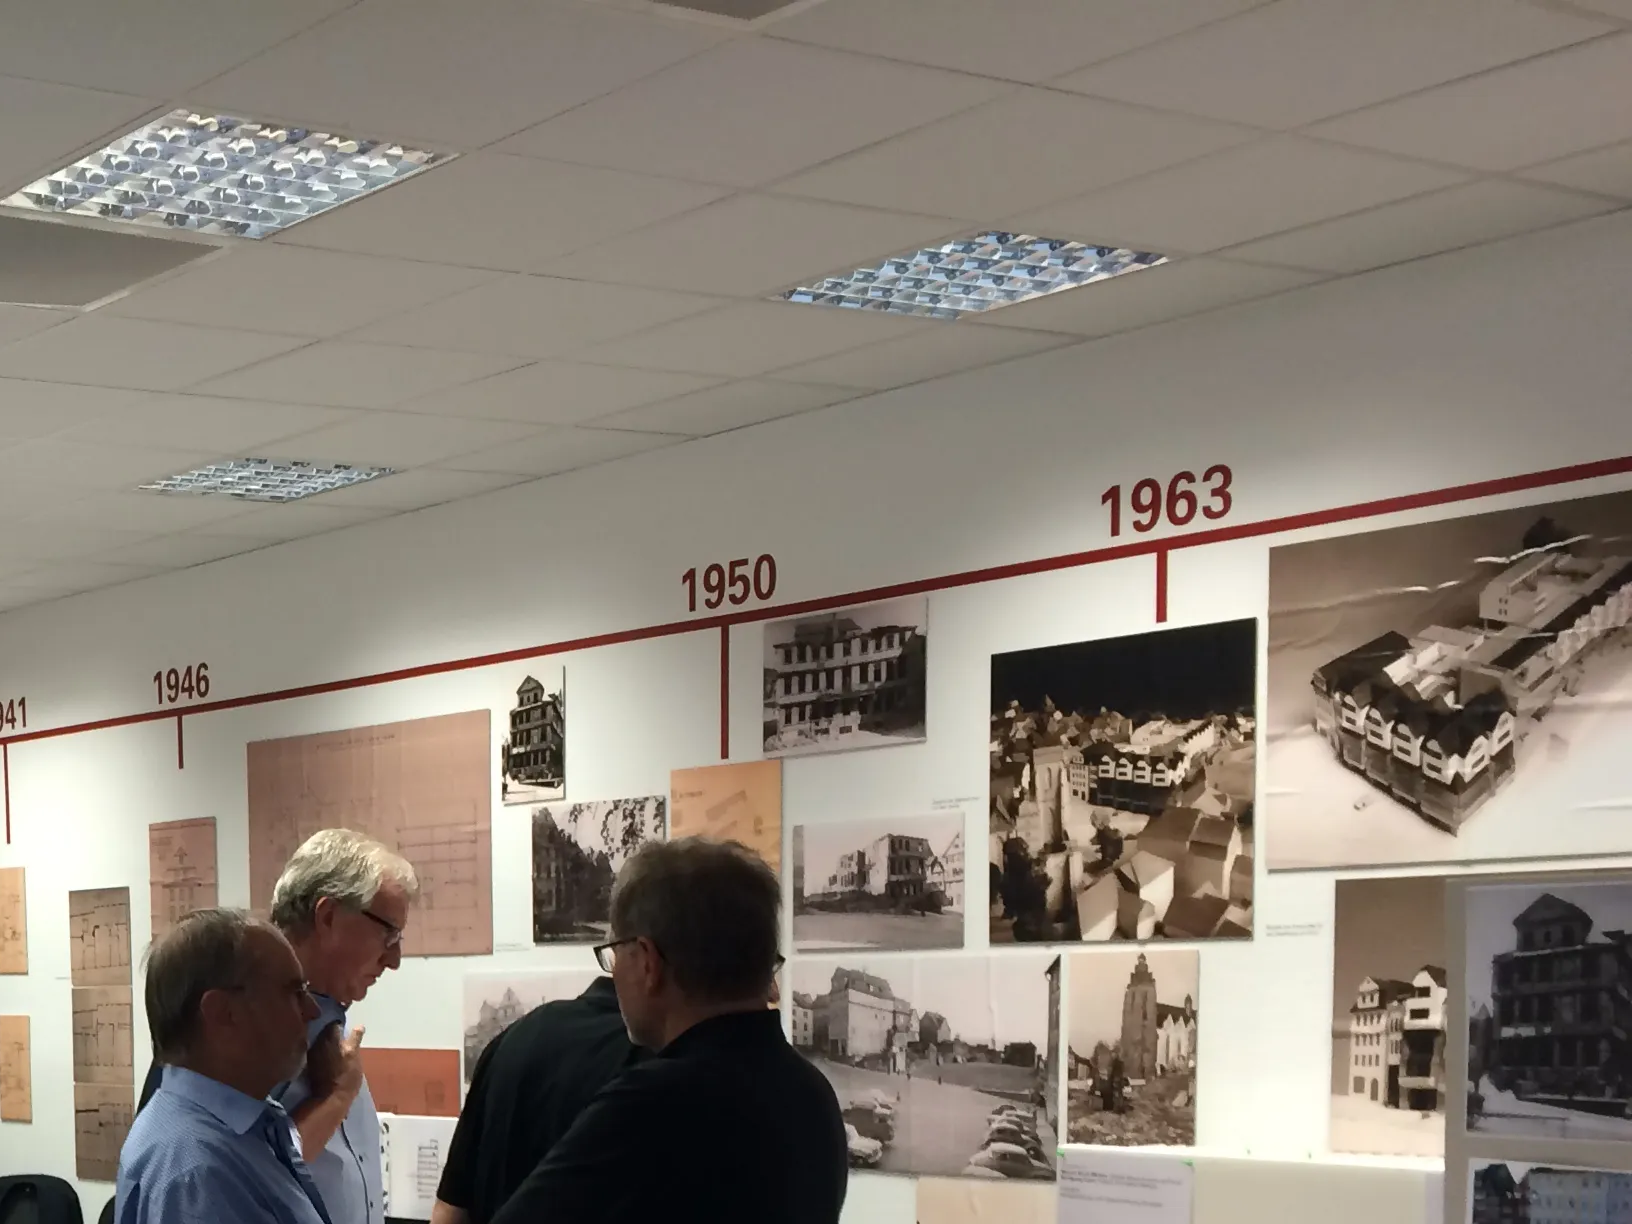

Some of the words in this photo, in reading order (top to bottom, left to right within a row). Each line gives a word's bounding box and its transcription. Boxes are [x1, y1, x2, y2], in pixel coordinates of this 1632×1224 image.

[1101, 463, 1234, 538] 1963
[680, 553, 778, 613] 1950
[153, 662, 210, 705] 1946
